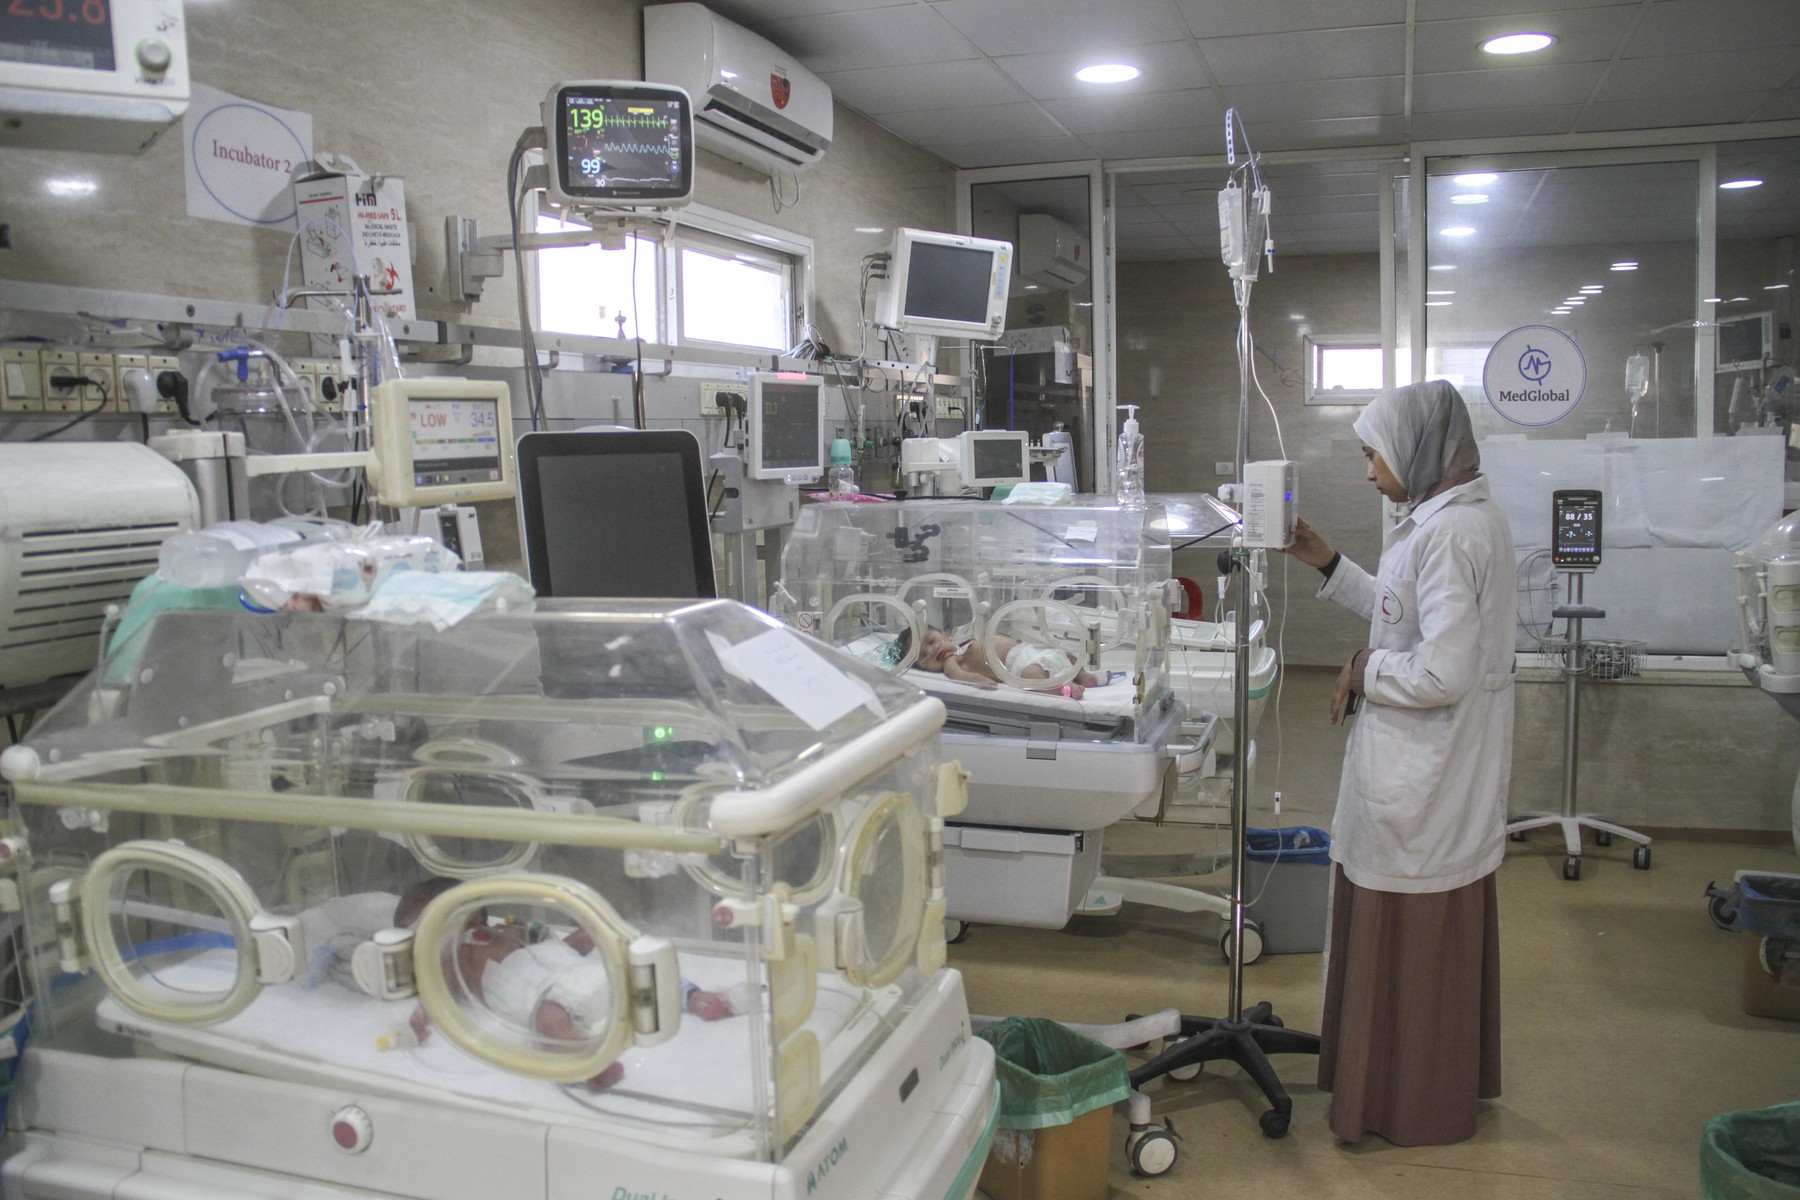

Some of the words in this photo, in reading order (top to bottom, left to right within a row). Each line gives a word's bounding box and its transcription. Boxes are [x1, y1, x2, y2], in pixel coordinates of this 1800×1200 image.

[570, 108, 604, 129] 139
[213, 139, 281, 172] Incubator
[284, 159, 292, 174] 2
[581, 159, 601, 175] 99
[595, 178, 606, 188] 30
[1499, 389, 1570, 402] MedGlobal
[420, 413, 447, 428] LOW
[471, 411, 495, 428] 34.5
[1582, 513, 1593, 521] 35
[816, 1136, 848, 1179] ATOM
